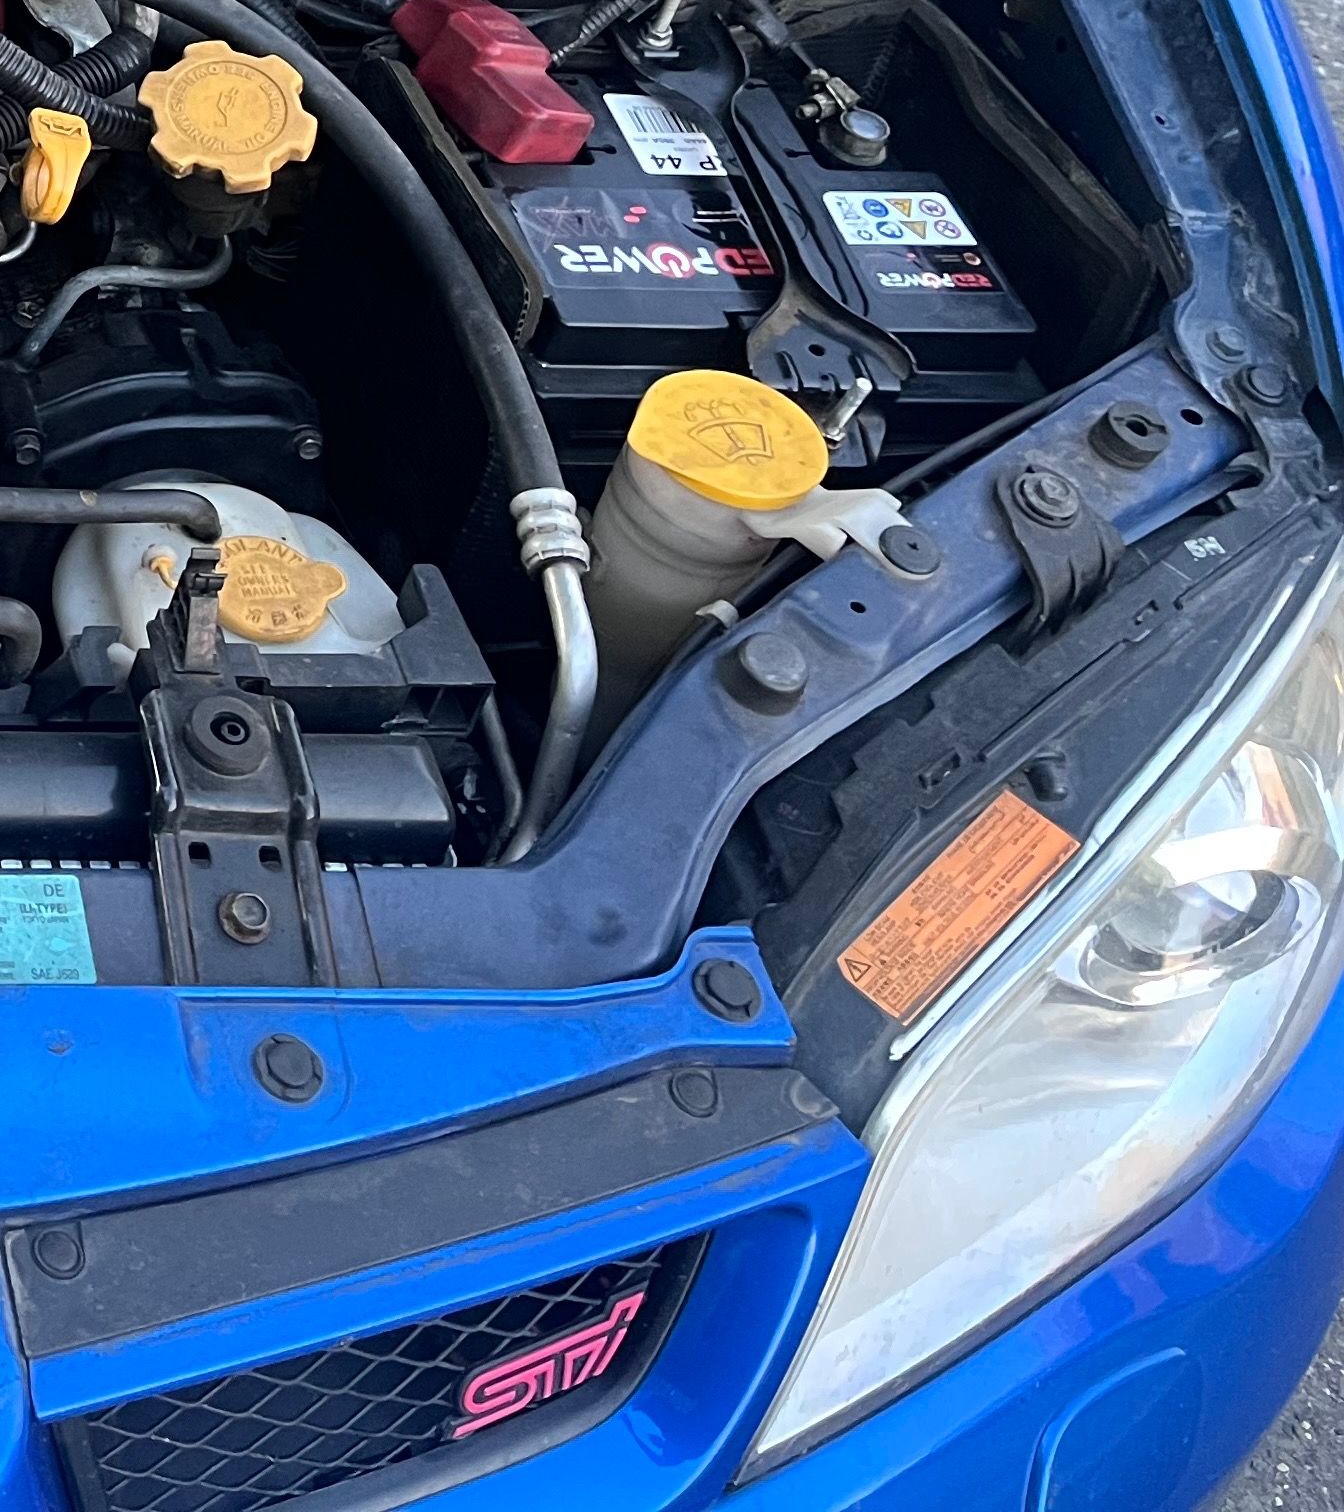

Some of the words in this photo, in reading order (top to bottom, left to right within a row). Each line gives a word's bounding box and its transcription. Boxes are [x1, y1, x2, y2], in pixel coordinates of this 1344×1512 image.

[259, 82, 282, 134] ENGINE
[558, 244, 774, 277] EDPOWER
[43, 884, 65, 898] DE
